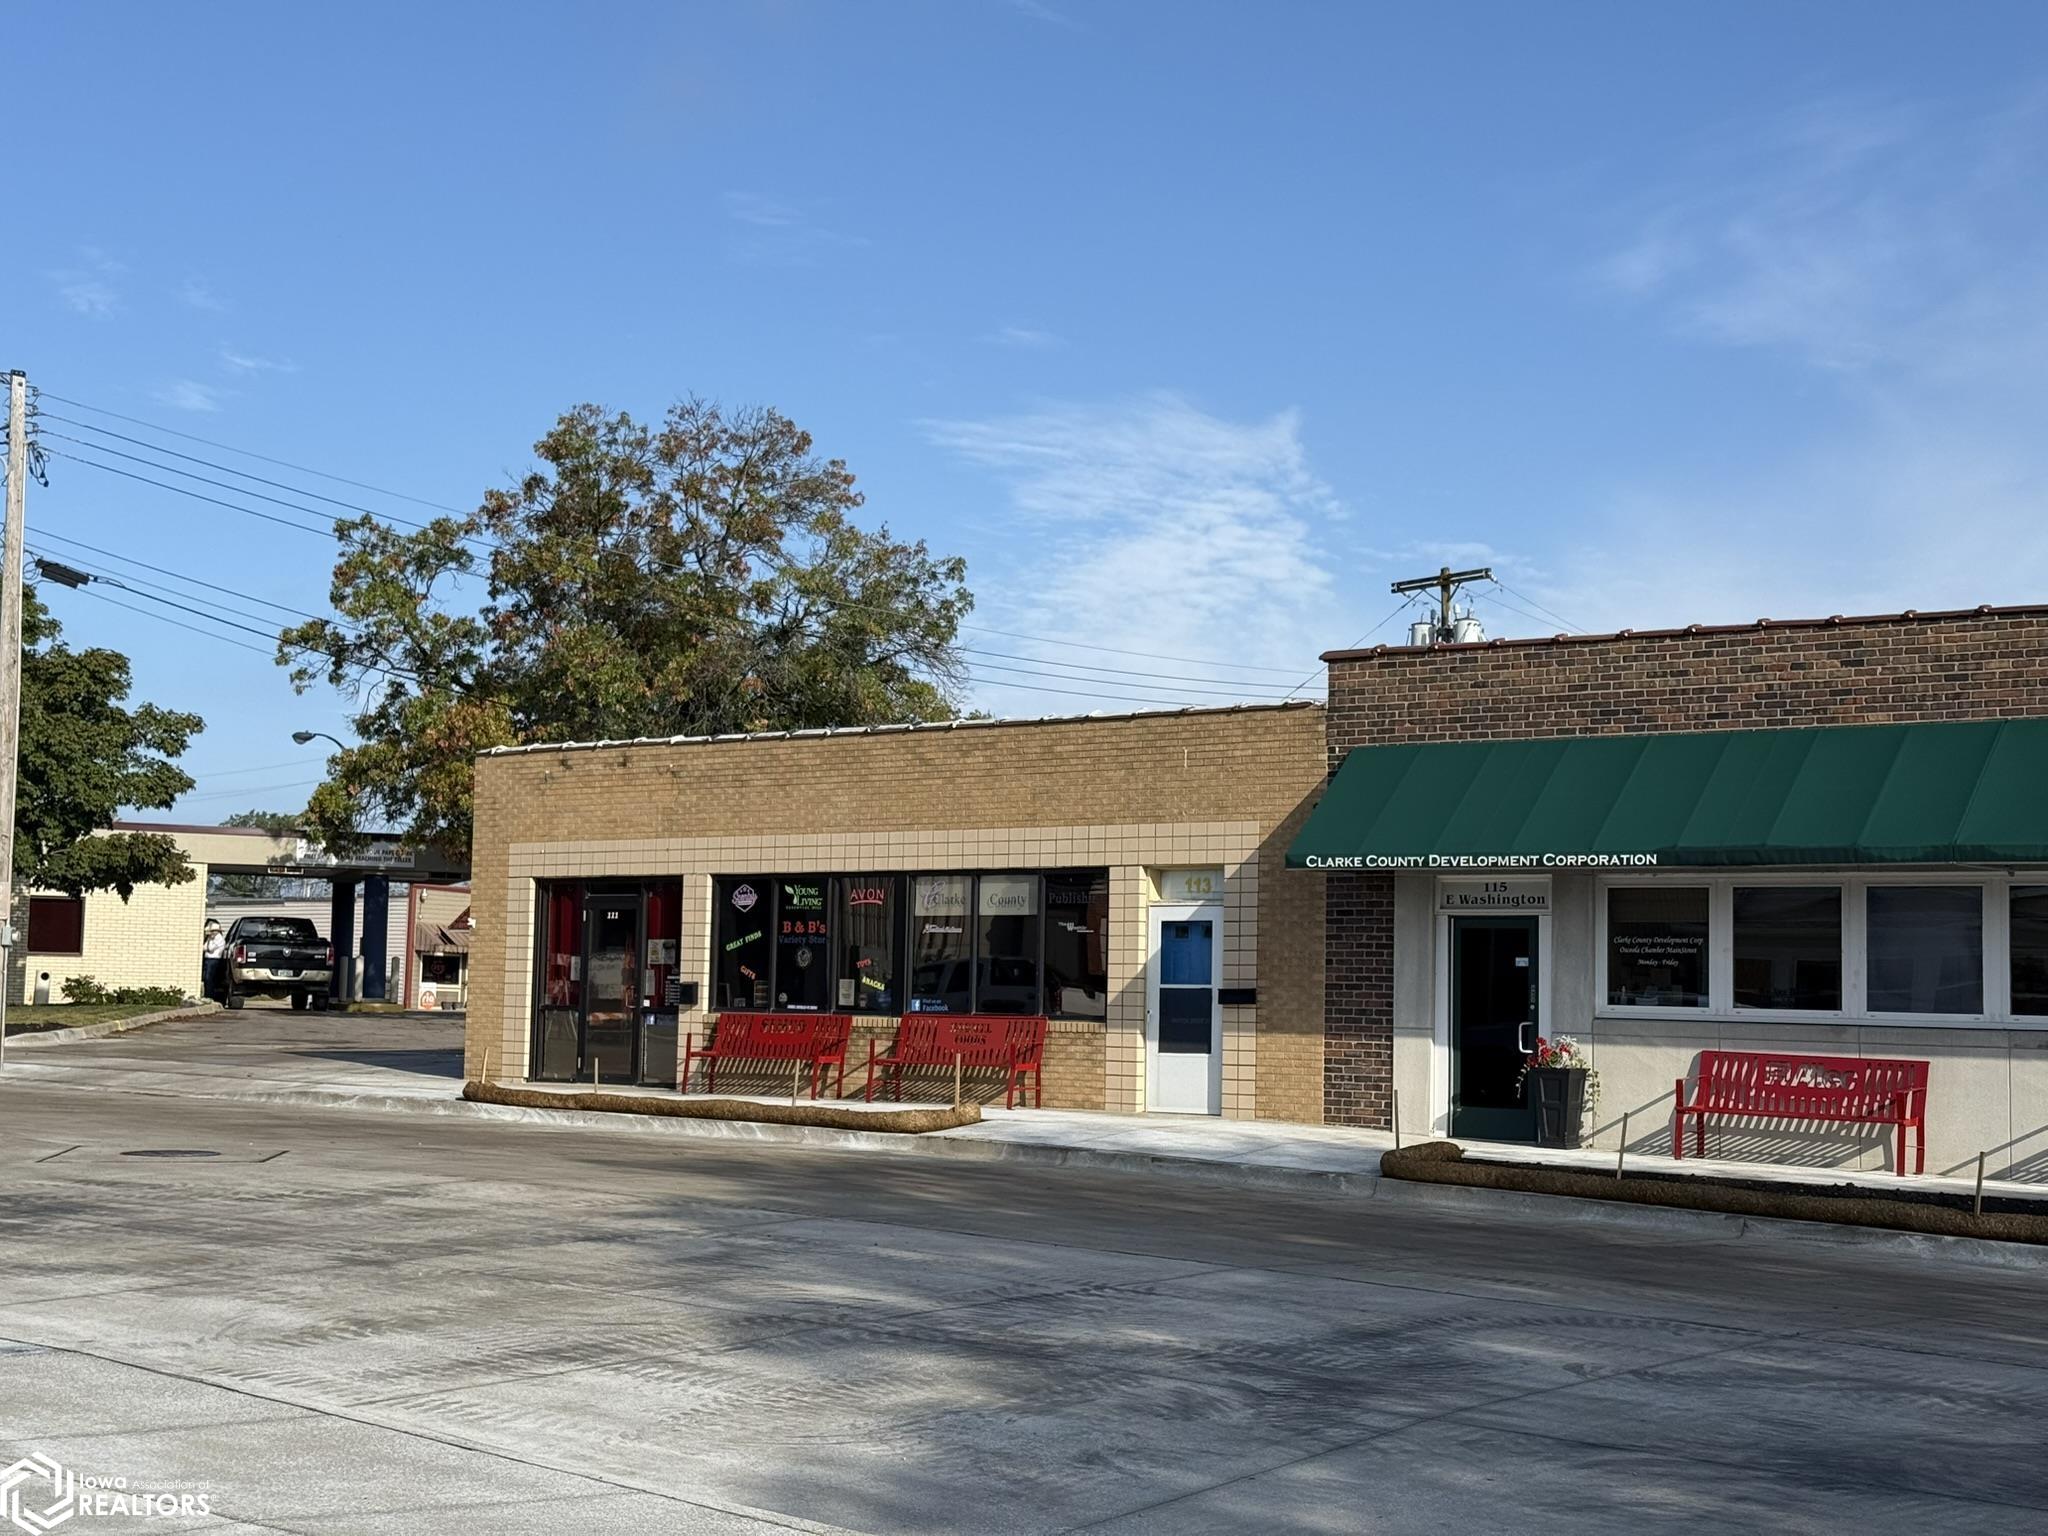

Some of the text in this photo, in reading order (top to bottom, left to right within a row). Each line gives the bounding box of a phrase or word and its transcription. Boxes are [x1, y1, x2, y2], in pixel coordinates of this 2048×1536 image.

[1306, 853, 1658, 867] CLARKE COUNTY DEVELOPMENT CORPORATION
[794, 885, 819, 896] YOUNG
[1186, 877, 1212, 894] 113
[1485, 882, 1508, 892] 115
[850, 887, 885, 900] AVON
[989, 892, 1026, 907] County
[1446, 893, 1546, 907] E Washington
[797, 895, 823, 906] LIVING
[606, 911, 619, 920] 111
[783, 920, 826, 934] B & B's
[725, 937, 744, 951] GREAT
[808, 935, 827, 945] Stor
[1632, 936, 1653, 945] County
[1654, 936, 1689, 945] Development
